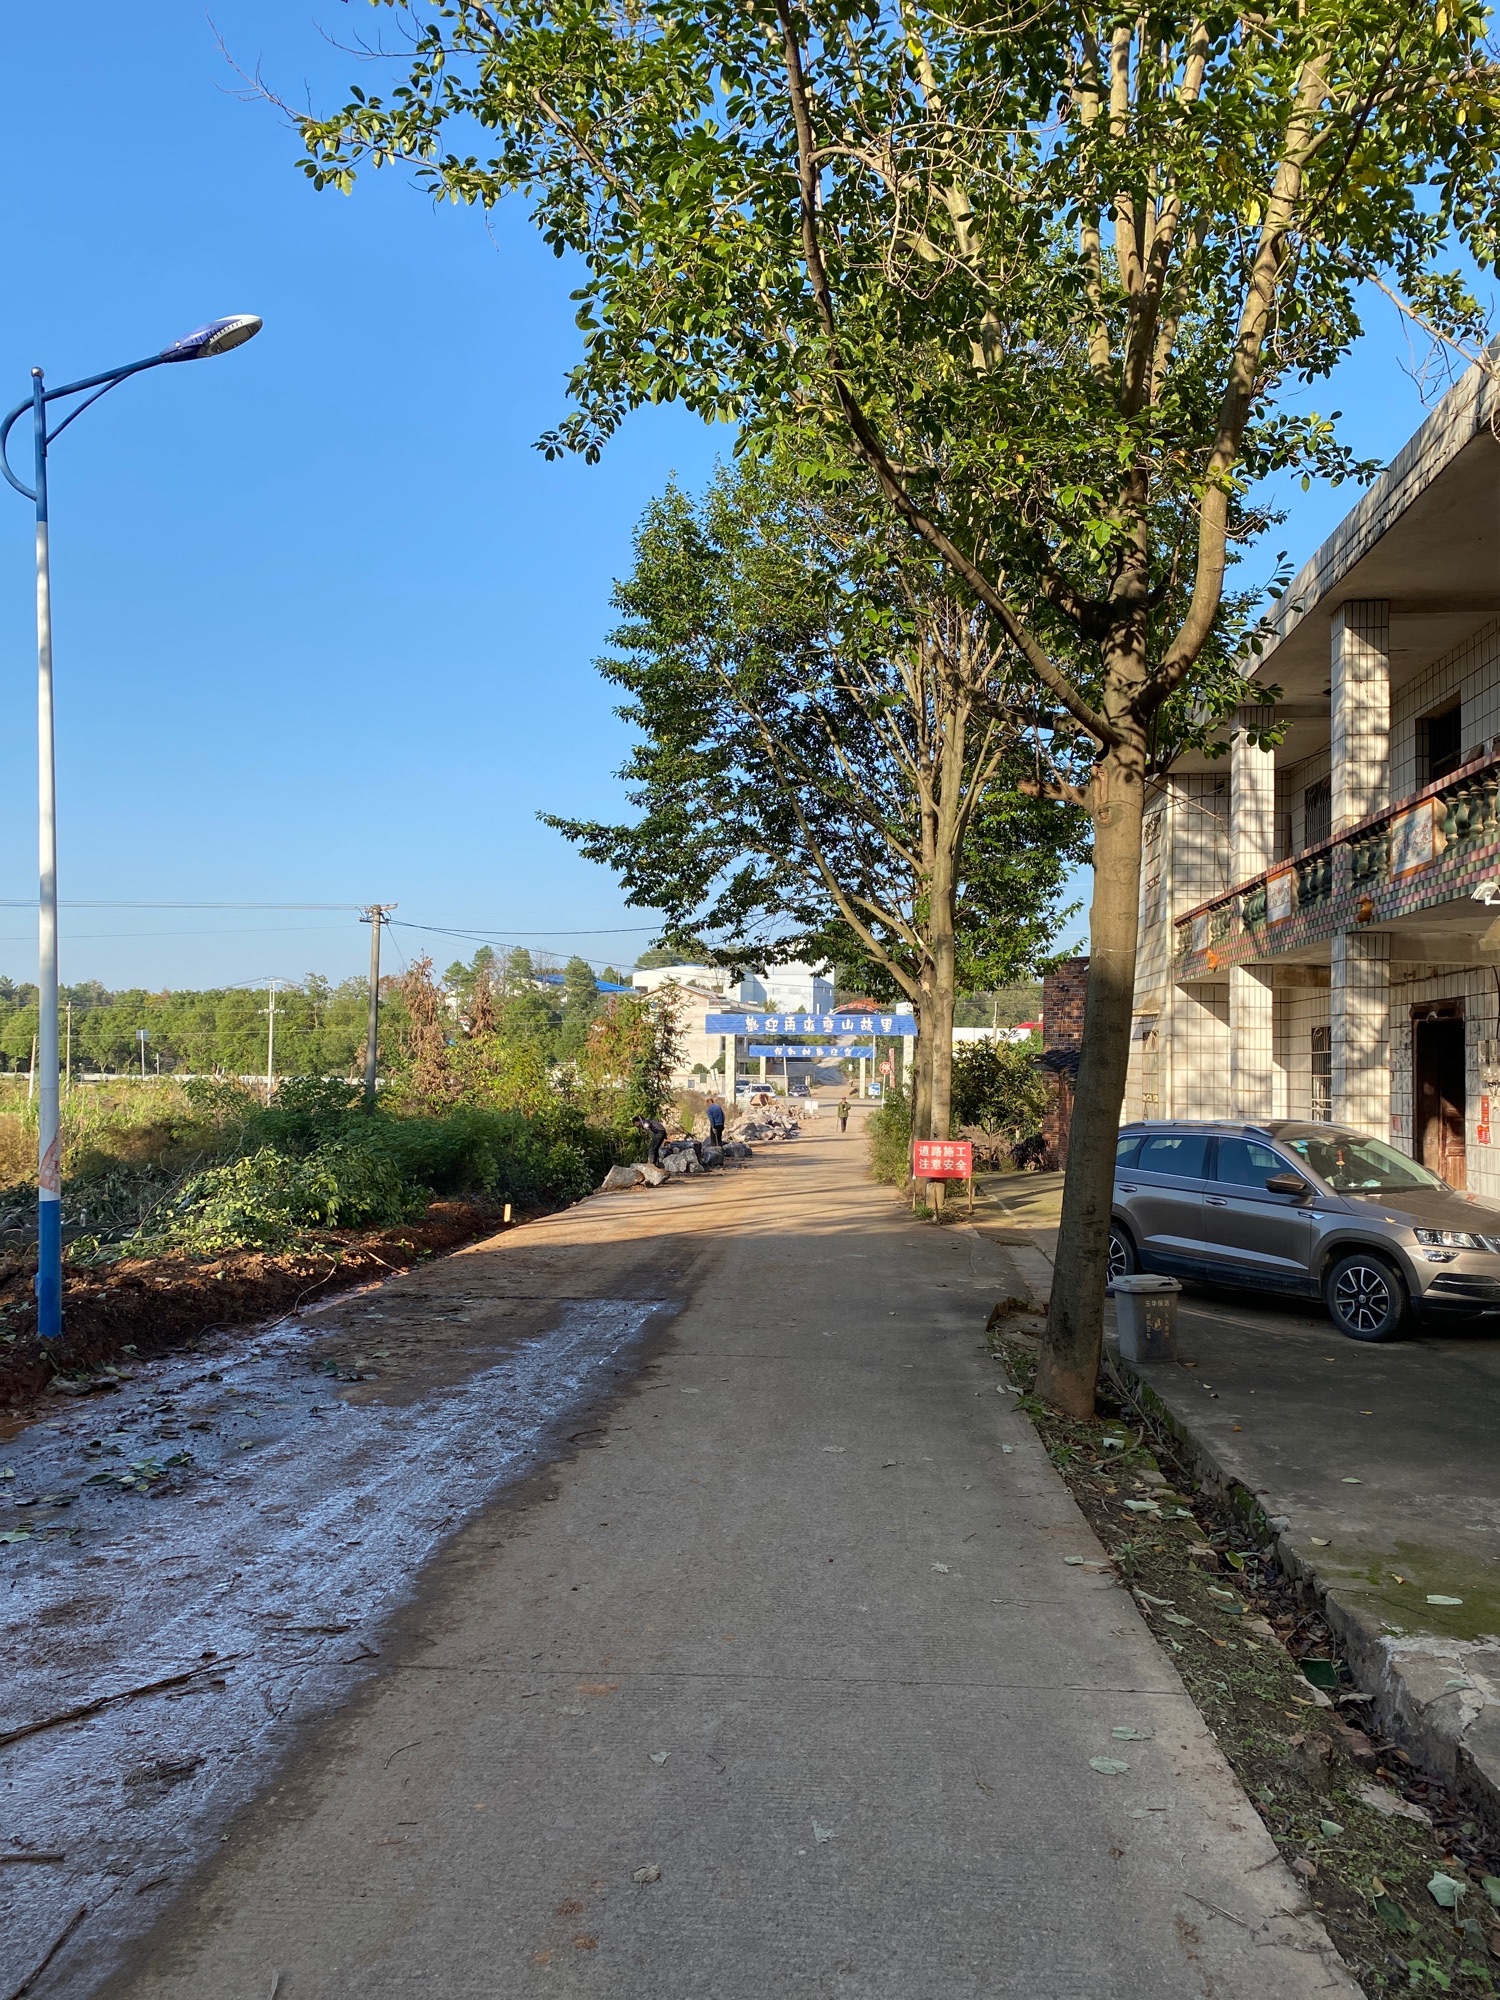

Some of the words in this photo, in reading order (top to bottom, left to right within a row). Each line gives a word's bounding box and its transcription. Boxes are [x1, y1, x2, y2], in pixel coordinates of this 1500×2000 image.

[918, 1145, 967, 1157] 道路施工
[918, 1158, 967, 1171] 注意安全
